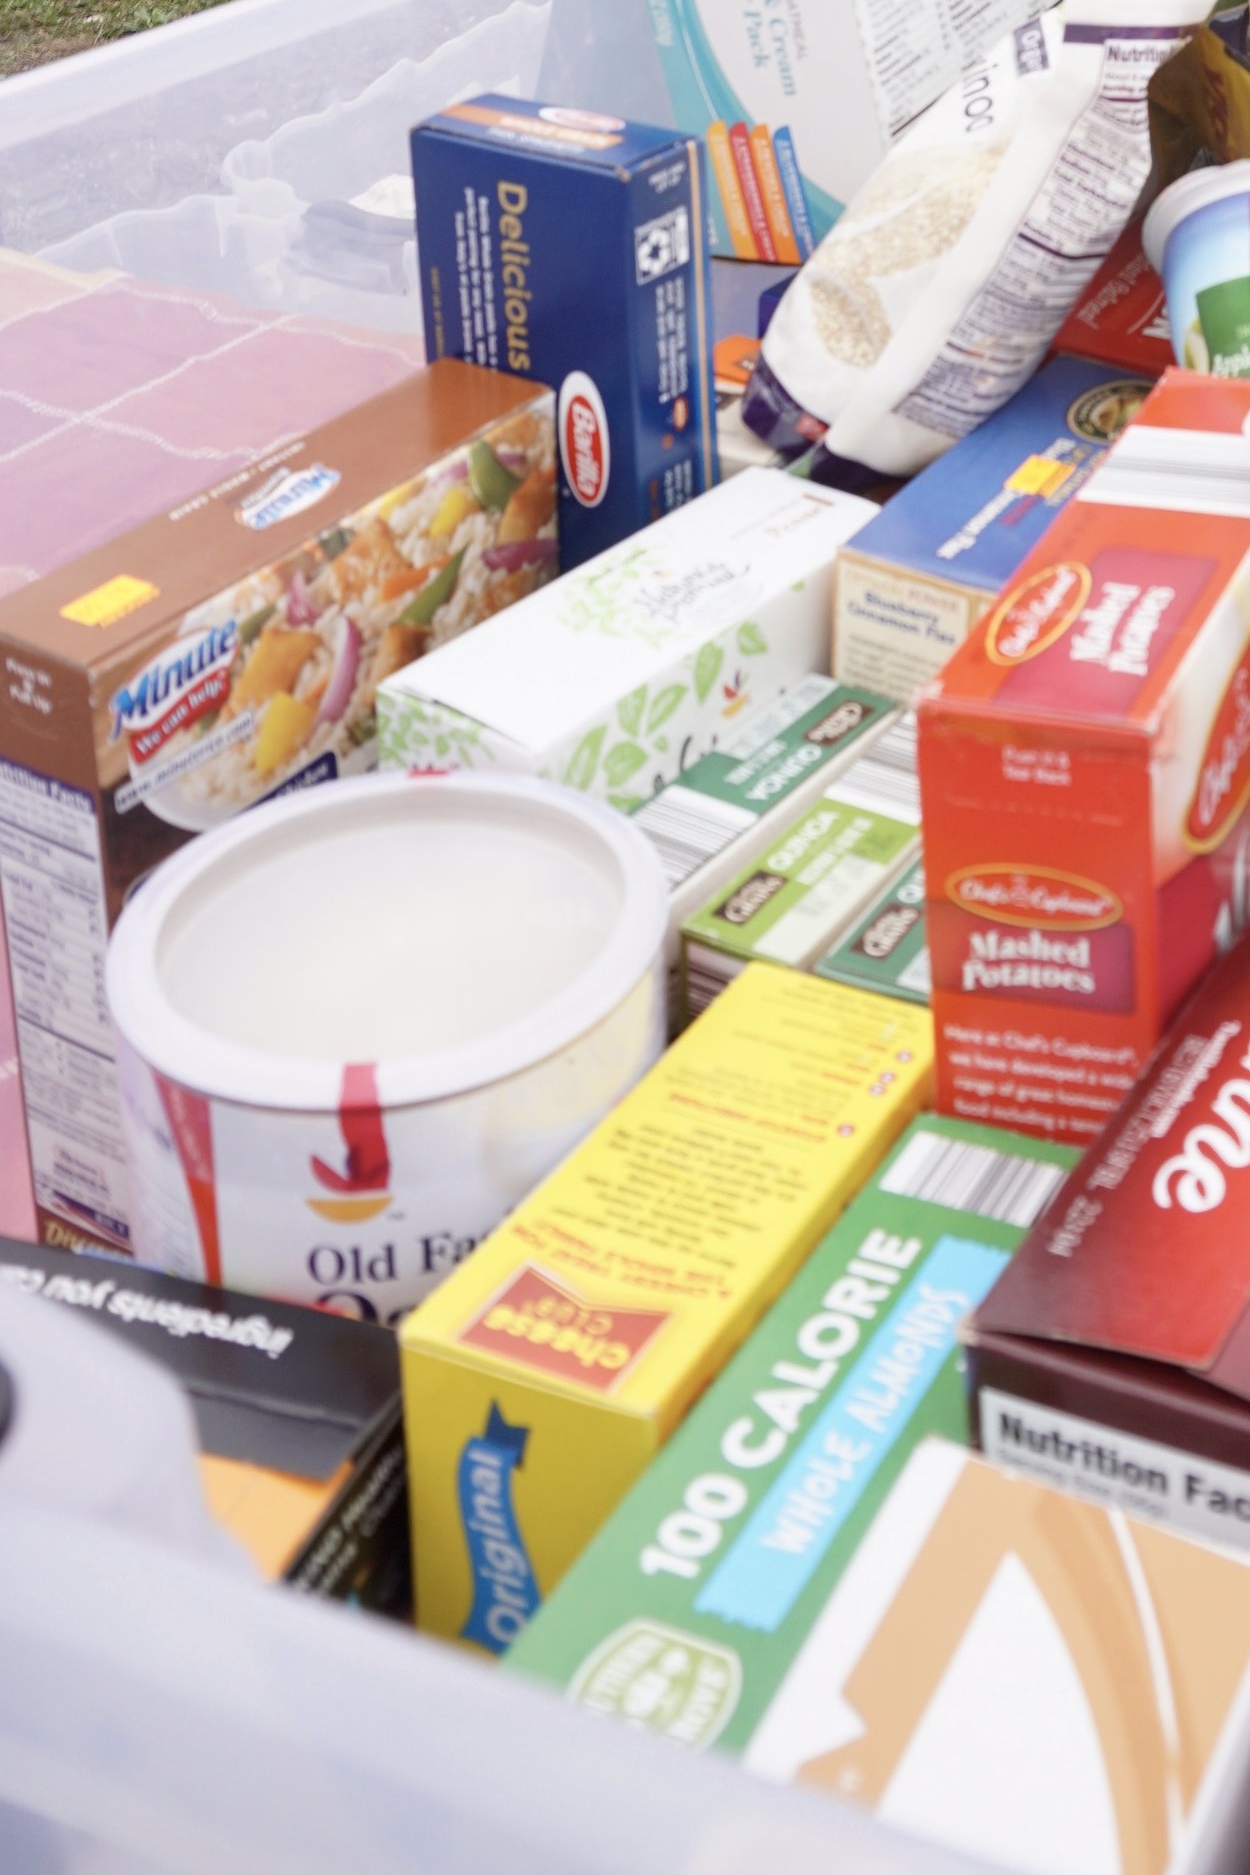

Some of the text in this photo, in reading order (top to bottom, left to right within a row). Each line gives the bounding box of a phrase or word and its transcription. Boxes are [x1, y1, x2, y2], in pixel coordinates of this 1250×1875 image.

[742, 10, 771, 68] Pack
[769, 18, 798, 97] Cream
[497, 180, 533, 372] Delicious
[570, 400, 604, 506] Barilla
[847, 599, 957, 648] Cinnamon Flax
[864, 590, 940, 626] Blueberry
[1069, 580, 1142, 663] Mashed
[108, 619, 238, 746] Minute
[745, 743, 823, 802] QUINOA
[767, 810, 839, 871] QUINOA
[958, 876, 1010, 907] Chef's
[962, 959, 1098, 995] Potatoes
[967, 928, 1092, 970] Mashed
[954, 1076, 996, 1099] range
[1011, 1056, 1086, 1084] developed
[953, 1096, 990, 1118] food
[992, 1101, 1056, 1133] including
[306, 1239, 398, 1286] Old
[639, 1470, 749, 1581] 100
[720, 1226, 924, 1471] CALORIE
[758, 1281, 974, 1557] WHOLE ALMONDS
[998, 1411, 1171, 1496] Nutrition
